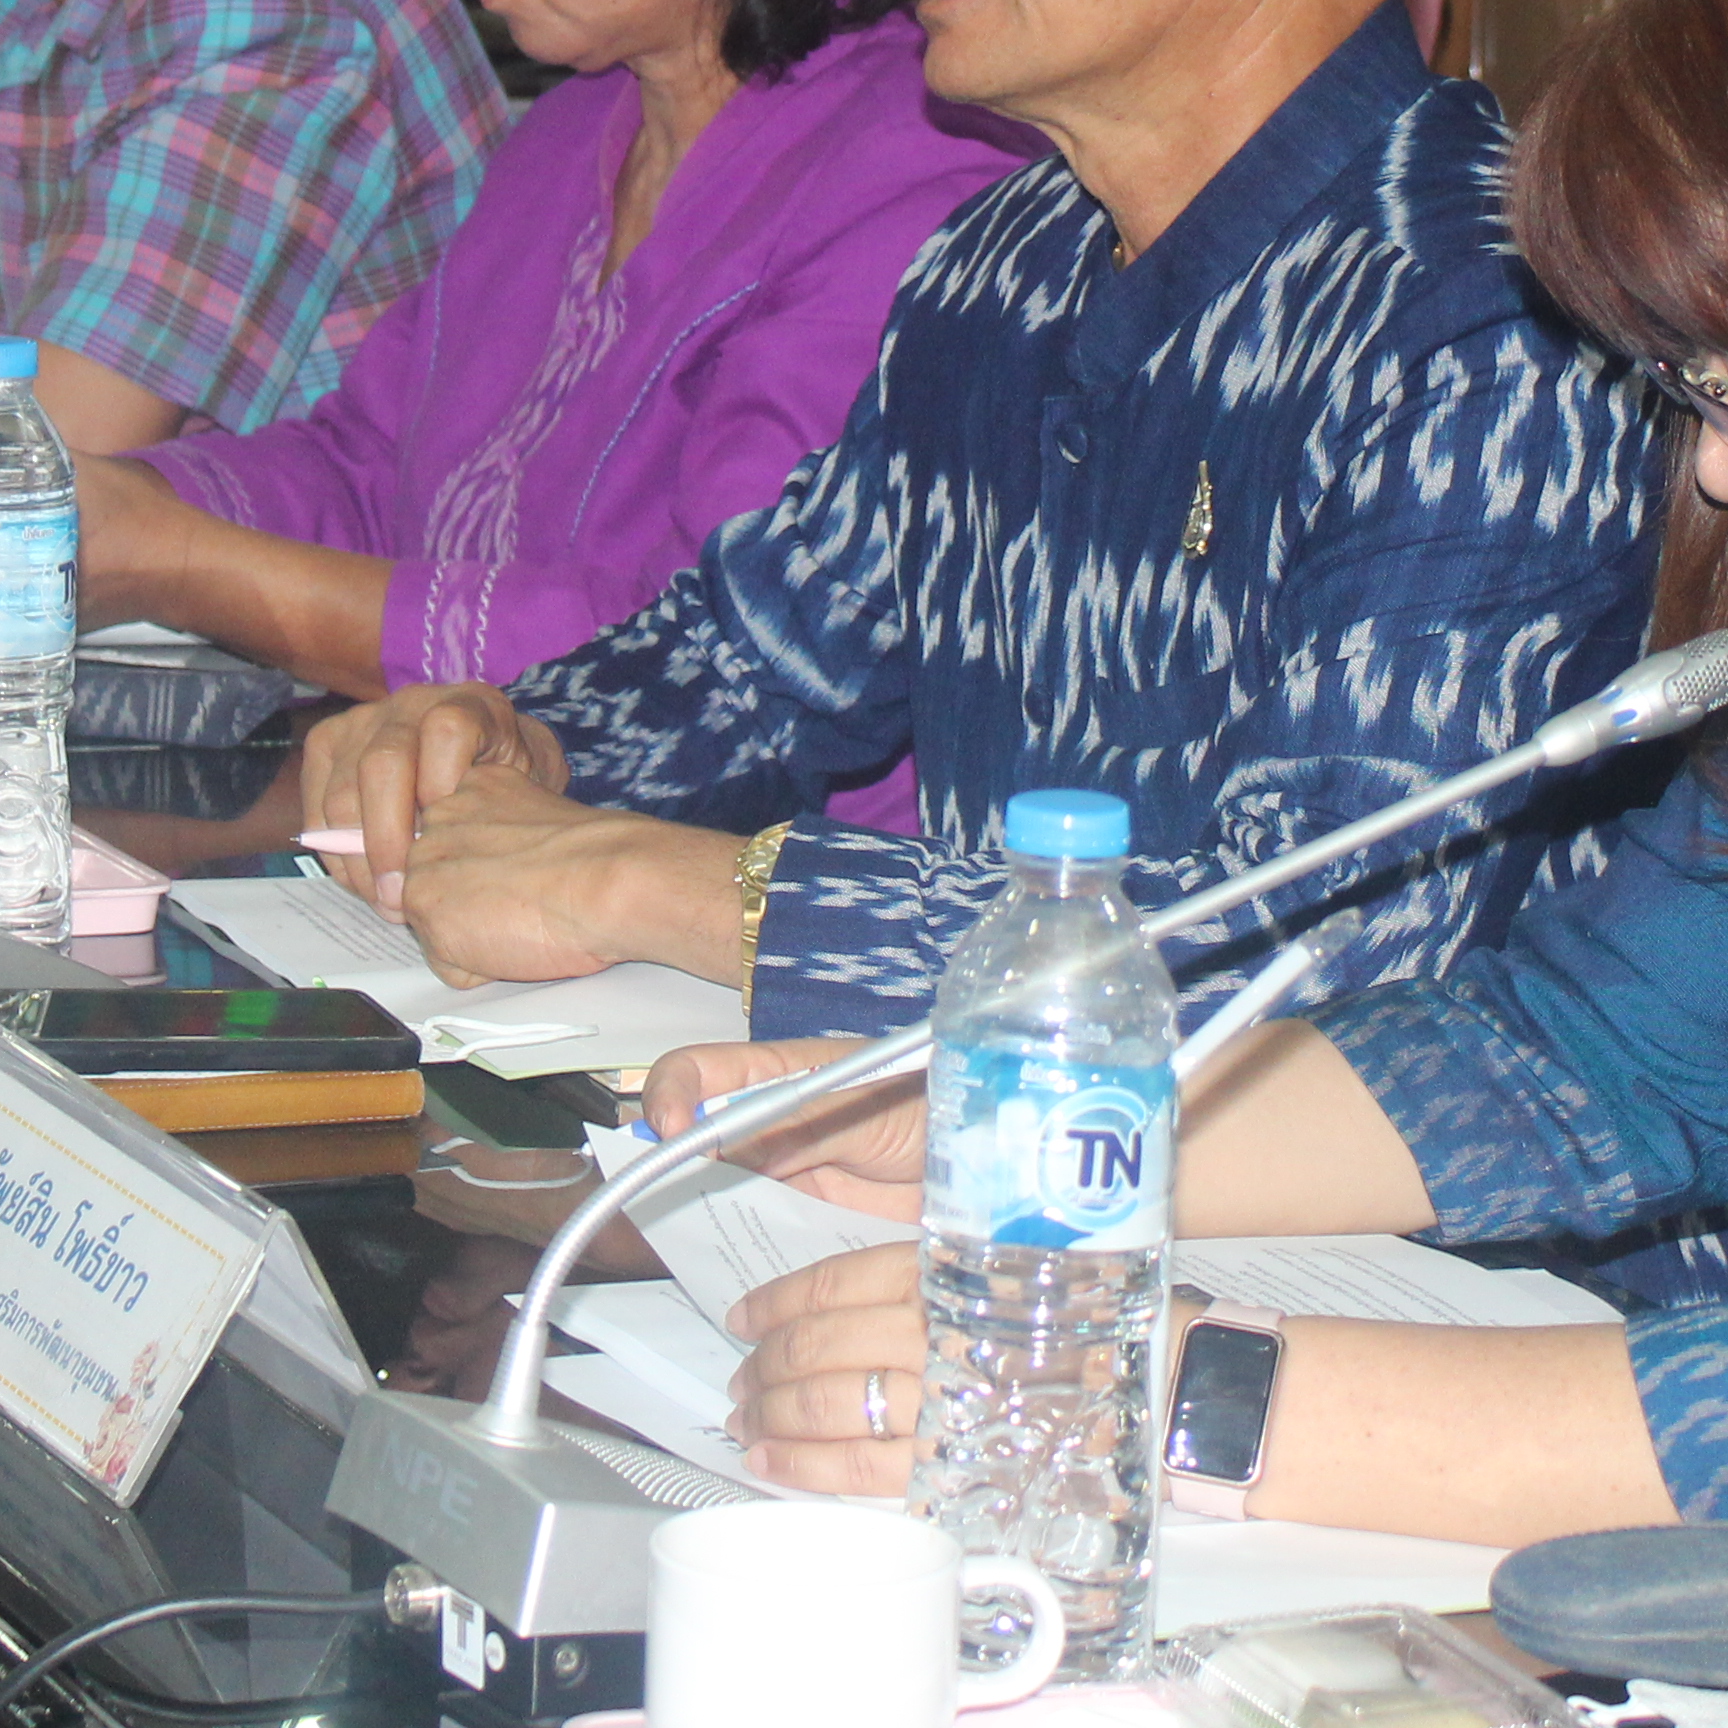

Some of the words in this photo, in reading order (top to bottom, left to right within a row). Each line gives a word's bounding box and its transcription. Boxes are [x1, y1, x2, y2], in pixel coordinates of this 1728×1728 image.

[1066, 1128, 1142, 1189] TN
[53, 1199, 149, 1312] โพธิ์ขาว
